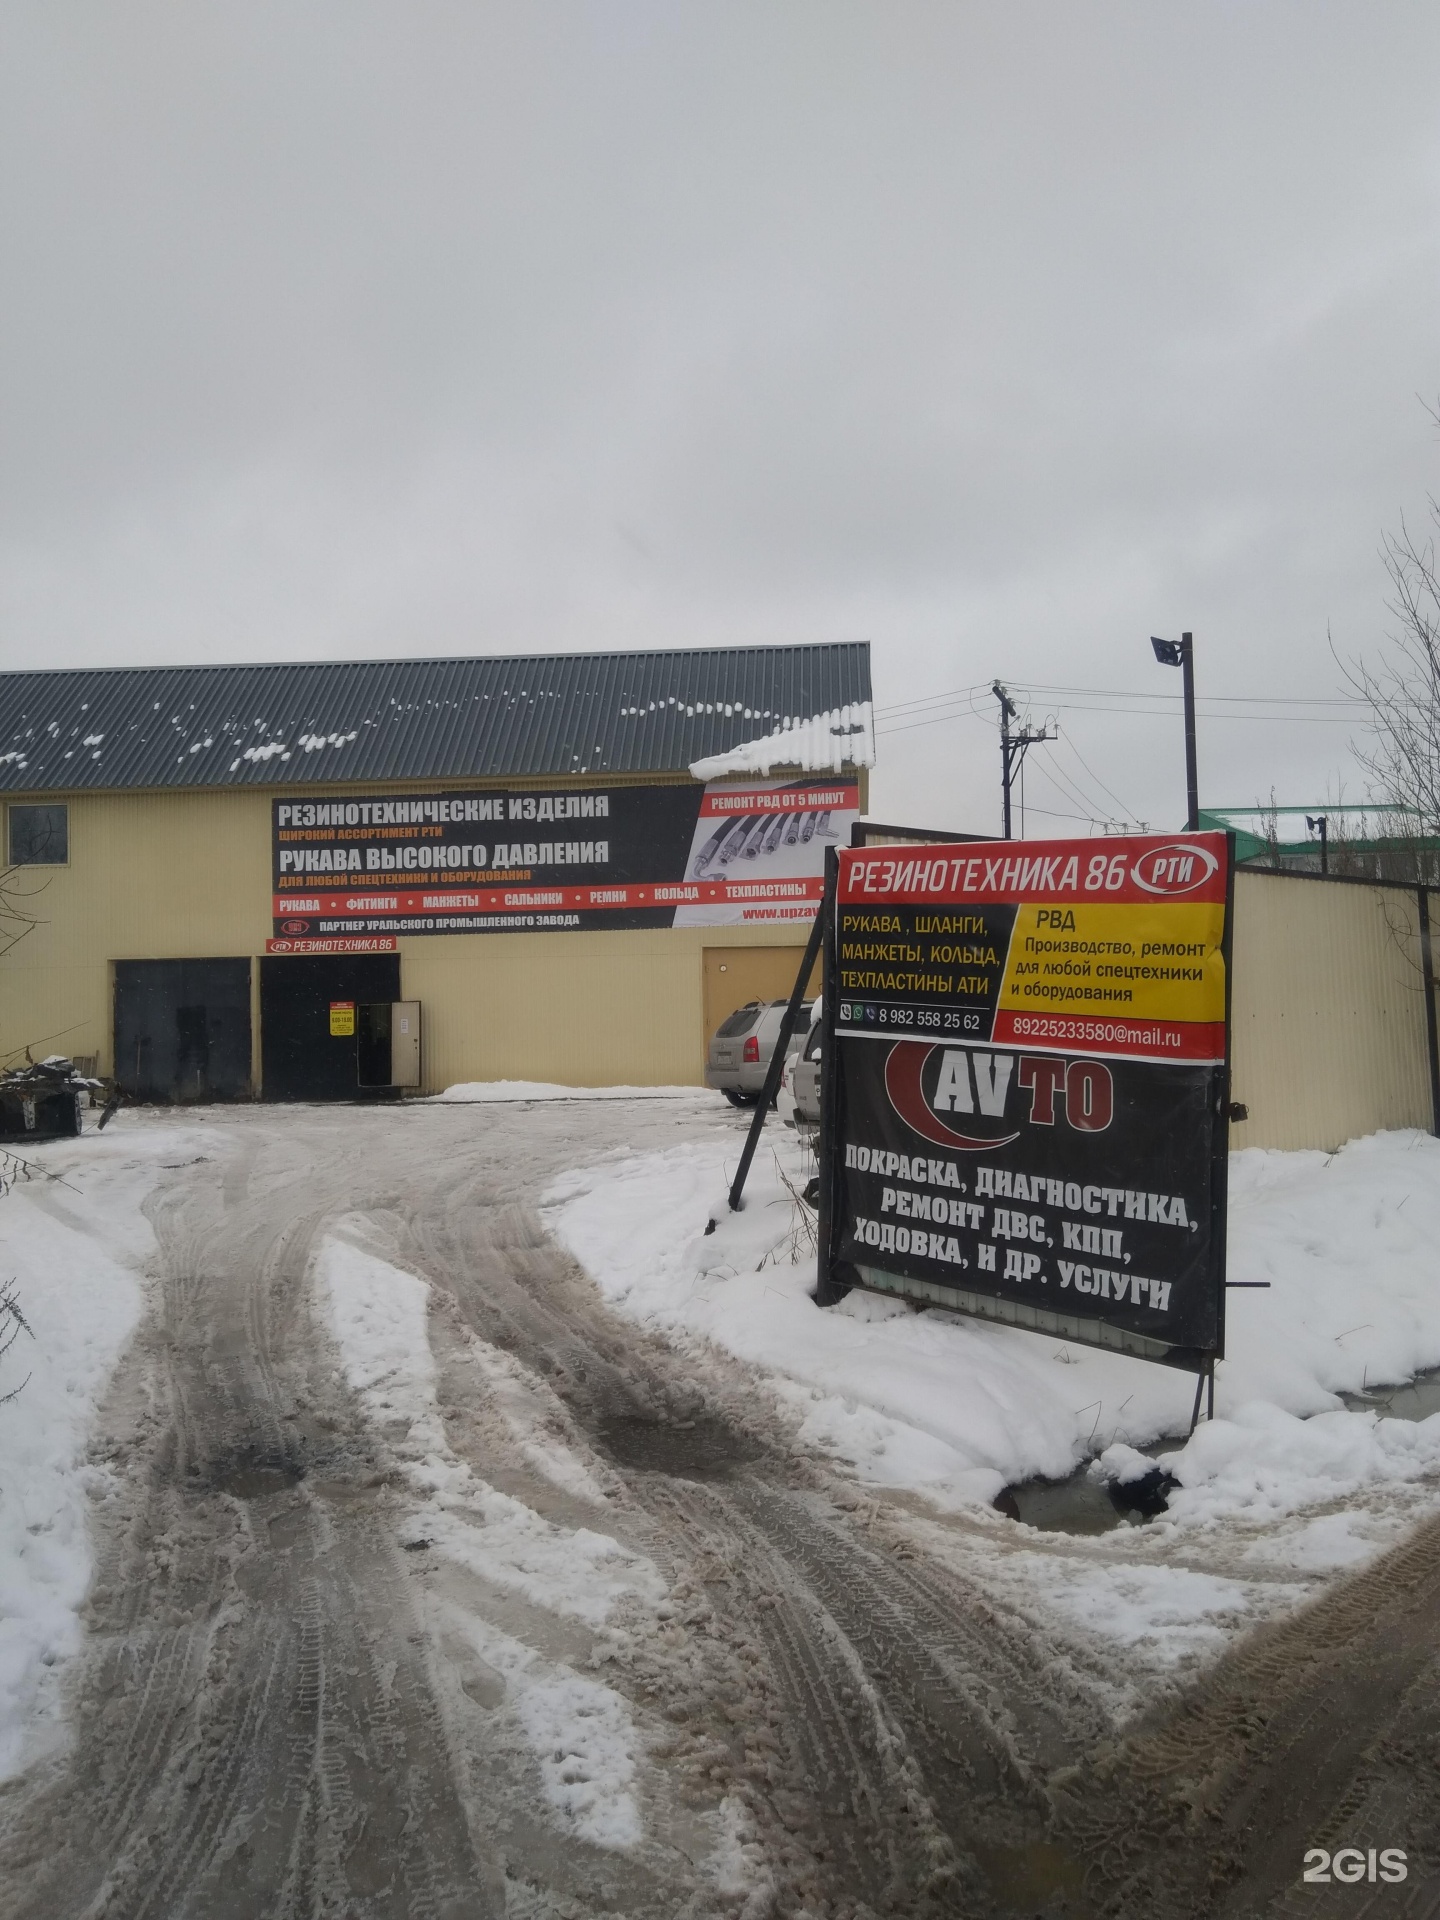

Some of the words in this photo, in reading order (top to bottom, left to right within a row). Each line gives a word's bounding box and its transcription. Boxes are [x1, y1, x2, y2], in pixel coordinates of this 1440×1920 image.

[279, 799, 504, 827] РЕЗИНОТЕХНИЧЕСКИЕ
[508, 796, 609, 822] ИЗДЕЛИЯ
[711, 796, 755, 810] РЕМОНТ
[757, 794, 780, 809] РВД
[782, 794, 796, 807] ОТ
[798, 793, 806, 806] 5
[808, 791, 845, 806] МИНУТ
[278, 828, 335, 842] ШИРОКИЙ
[337, 827, 419, 840] АССОРТИМЕНТ
[421, 826, 443, 838] РТИ
[279, 849, 362, 872] РУКАВА
[366, 845, 487, 870] ВЫСОКОГО
[491, 841, 609, 869] ДАВЛЕНИЯ
[278, 876, 303, 888] ДЛЯ
[305, 873, 348, 887] ЛЮБОЙ
[350, 872, 428, 886] СПЕЦТЕХНИКИ
[430, 872, 438, 883] И
[440, 870, 531, 883] ОБОРУДОВАНИЯ
[848, 857, 1078, 893] РЕЗИНОТЕХНИКА
[1084, 854, 1128, 891] 86
[1151, 856, 1194, 884] РТИ
[279, 900, 320, 912] РУКАВА
[346, 897, 398, 910] ФИТИНГИ
[422, 895, 479, 908] МАНЖЕТЫ
[504, 893, 563, 906] САЛЬНИКИ
[589, 890, 627, 903] РЕМНИ
[654, 887, 699, 900] КОЛЬЦА
[725, 883, 807, 897] ТЕХПЛАСТИНЫ
[320, 921, 365, 932] ПАРТНЕР
[366, 918, 434, 930] УРАЛЬСКОГО
[436, 915, 534, 929] ПРОМЫШЛЕННОГО
[536, 914, 580, 926] ЗАВОДА
[842, 916, 901, 932] РУКАВА
[915, 916, 988, 936] ШЛАНГИ,
[1036, 910, 1075, 932] РВД
[293, 939, 378, 952] РЕЗИНОТЕХНИКА
[378, 938, 392, 950] 86
[842, 943, 925, 964] МАНЖЕТЫ,
[930, 945, 1000, 968] КОЛЬЦА,
[1025, 937, 1136, 958] Производство,
[1141, 943, 1206, 959] ремонт
[1016, 962, 1039, 976] для
[1043, 960, 1091, 977] любой
[1096, 964, 1203, 981] спецтехники
[841, 971, 952, 993] ТЕХПЛАСТИНЫ
[957, 976, 989, 995] АТИ
[1011, 984, 1020, 996] и
[1024, 981, 1133, 1002] оборудования
[879, 1008, 887, 1023] 8
[890, 1009, 914, 1025] 982
[917, 1011, 940, 1027] 558
[944, 1013, 960, 1029] 25
[963, 1015, 980, 1031] 62
[1013, 1017, 1181, 1047] 89225233580@mail.ru
[845, 1143, 967, 1194] ПОКРАСКА,
[974, 1166, 1199, 1232] ДИАГНОСТИКА,
[881, 1187, 984, 1230] РЕМОНТ
[991, 1207, 1054, 1249] ДВС,
[1061, 1221, 1131, 1264] КПП,
[853, 1216, 969, 1270] ХОДОВКА,
[977, 1242, 997, 1273] И
[1003, 1250, 1048, 1284] ДР.
[1057, 1259, 1173, 1312] УСЛУГИ
